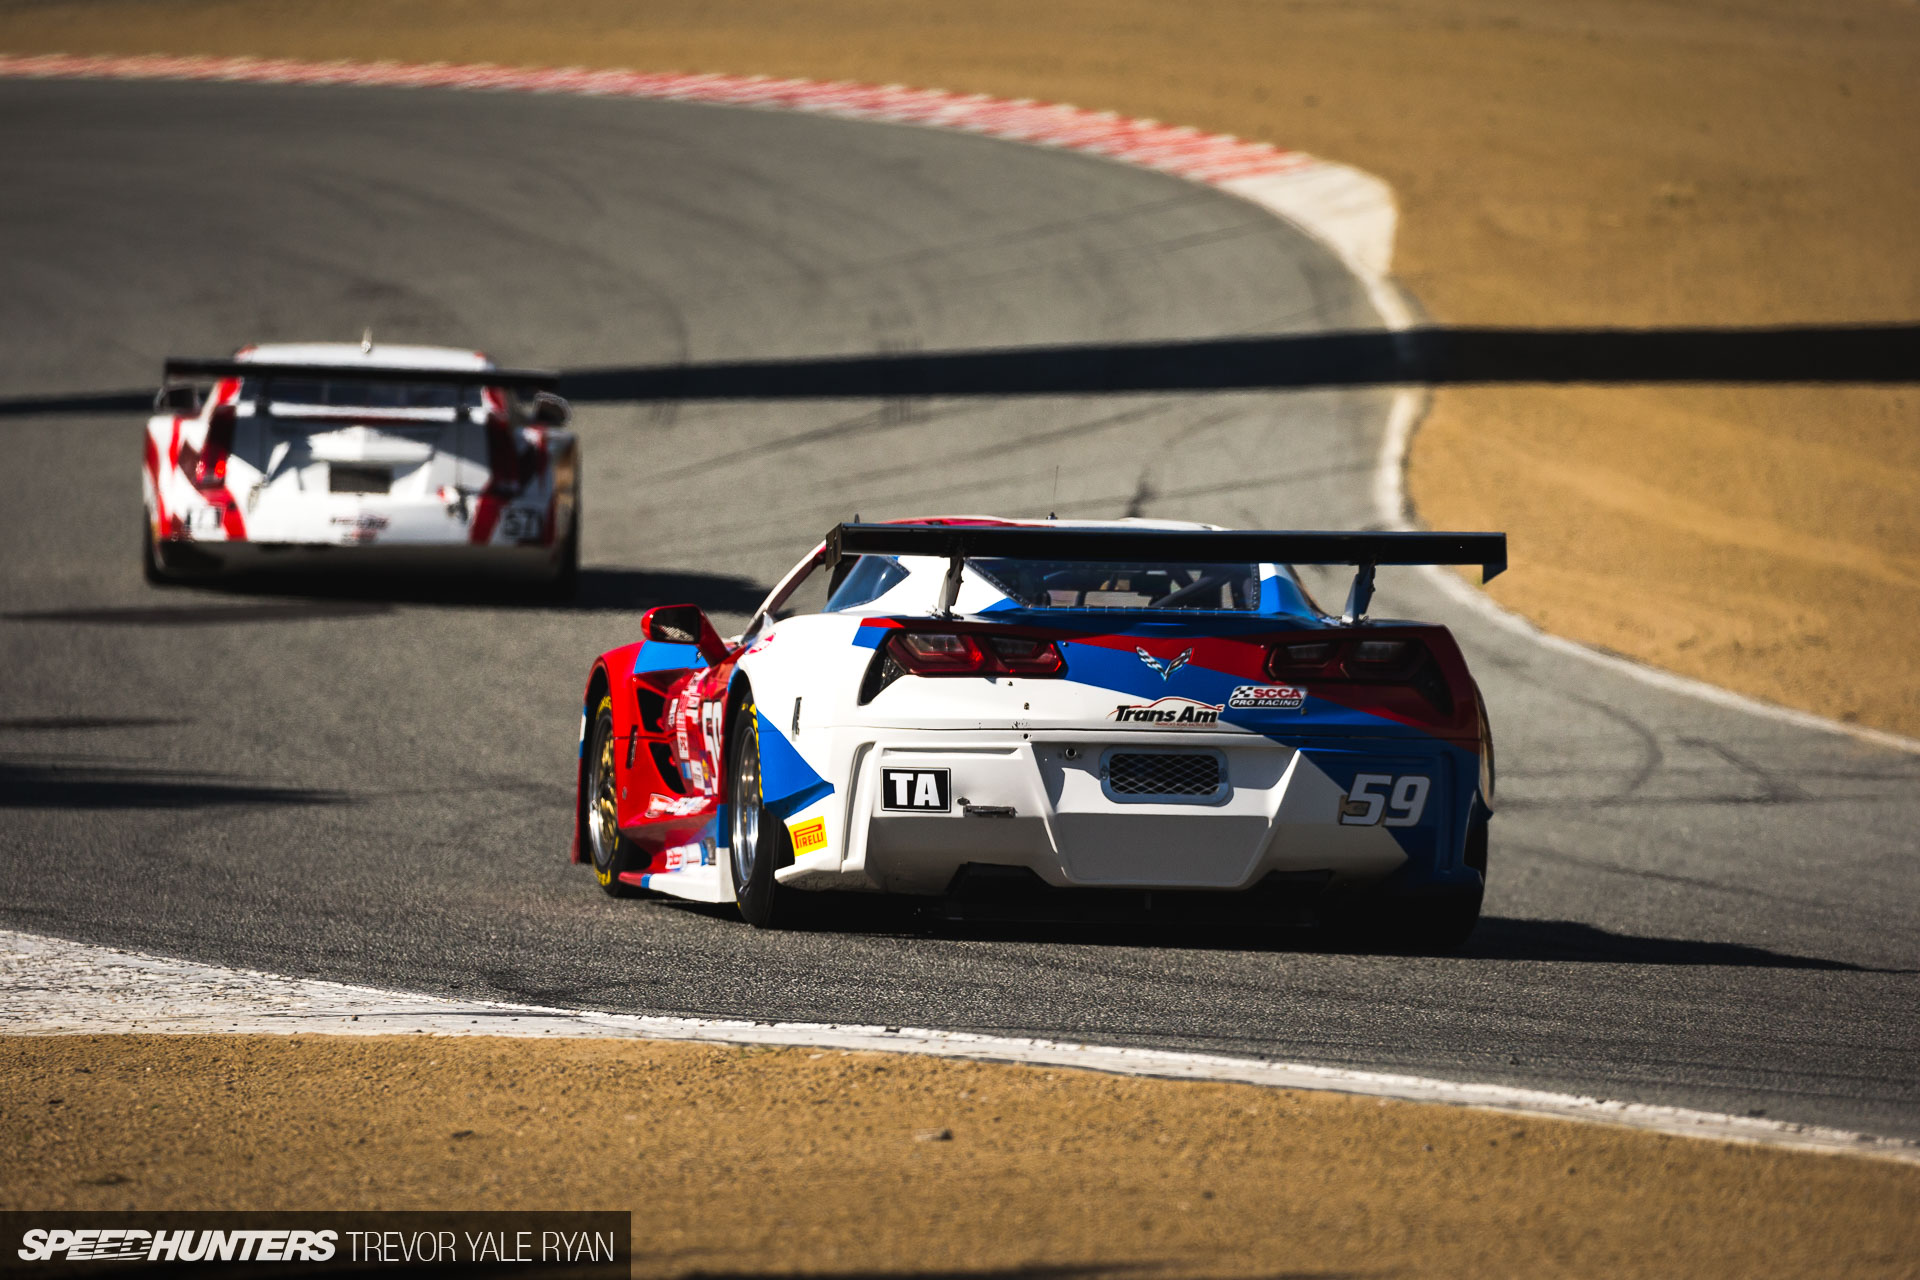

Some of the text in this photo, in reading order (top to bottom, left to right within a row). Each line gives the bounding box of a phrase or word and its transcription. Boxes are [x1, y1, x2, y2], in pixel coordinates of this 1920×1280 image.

[1231, 699, 1300, 707] PRO RACING
[1253, 688, 1302, 699] SCCA
[1115, 705, 1218, 723] Trans Am
[889, 772, 941, 807] TA
[1340, 773, 1431, 827] 59
[793, 823, 824, 849] PIRELLI
